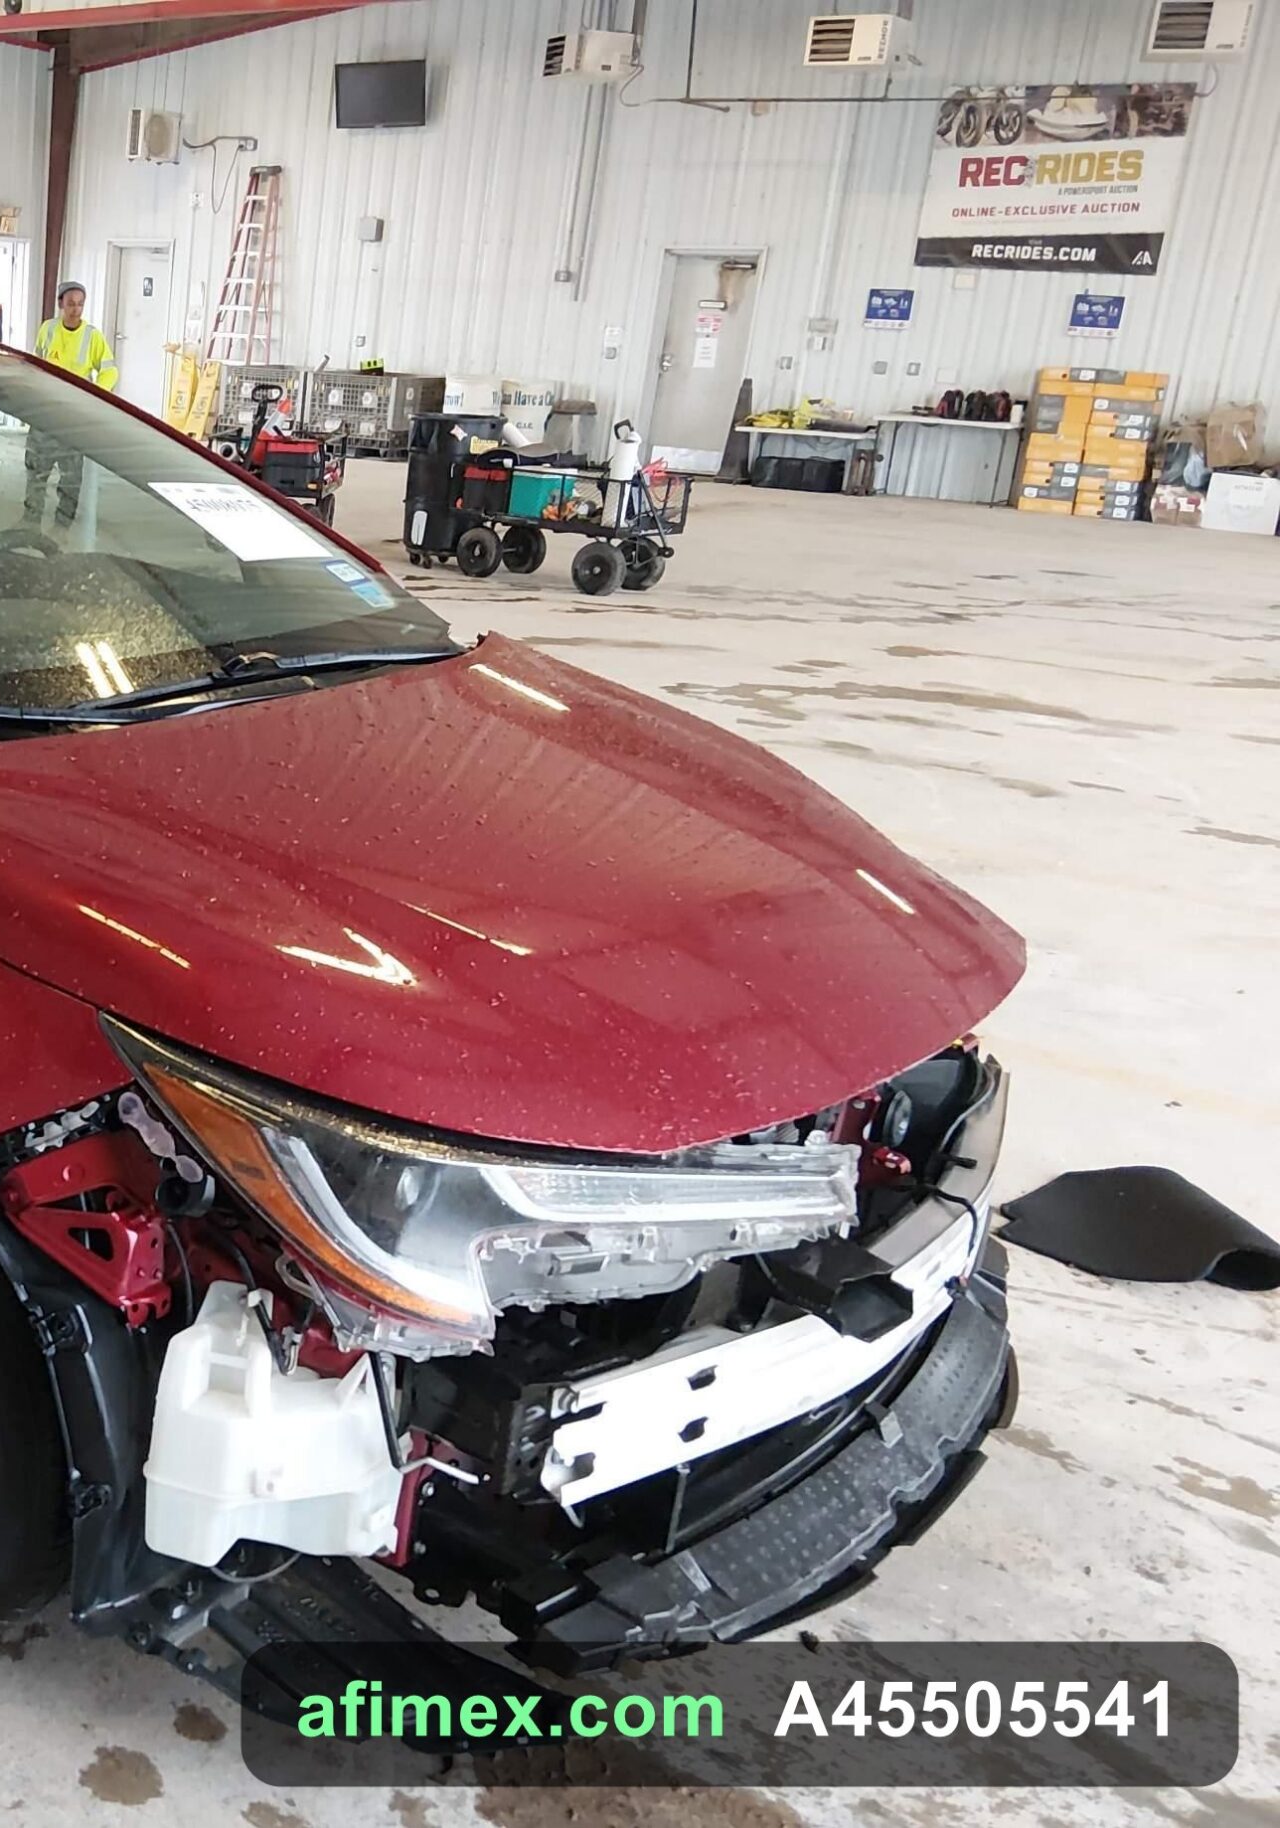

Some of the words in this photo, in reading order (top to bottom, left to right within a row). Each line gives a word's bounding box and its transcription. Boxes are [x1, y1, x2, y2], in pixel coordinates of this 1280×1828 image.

[959, 156, 1029, 187] REC
[1036, 150, 1144, 185] RIDES
[952, 204, 1077, 217] ONLINE-EXCLUSIVE
[1081, 202, 1140, 214] AUCTION
[971, 244, 1096, 261] RECRIDES.COM
[513, 390, 537, 406] Have
